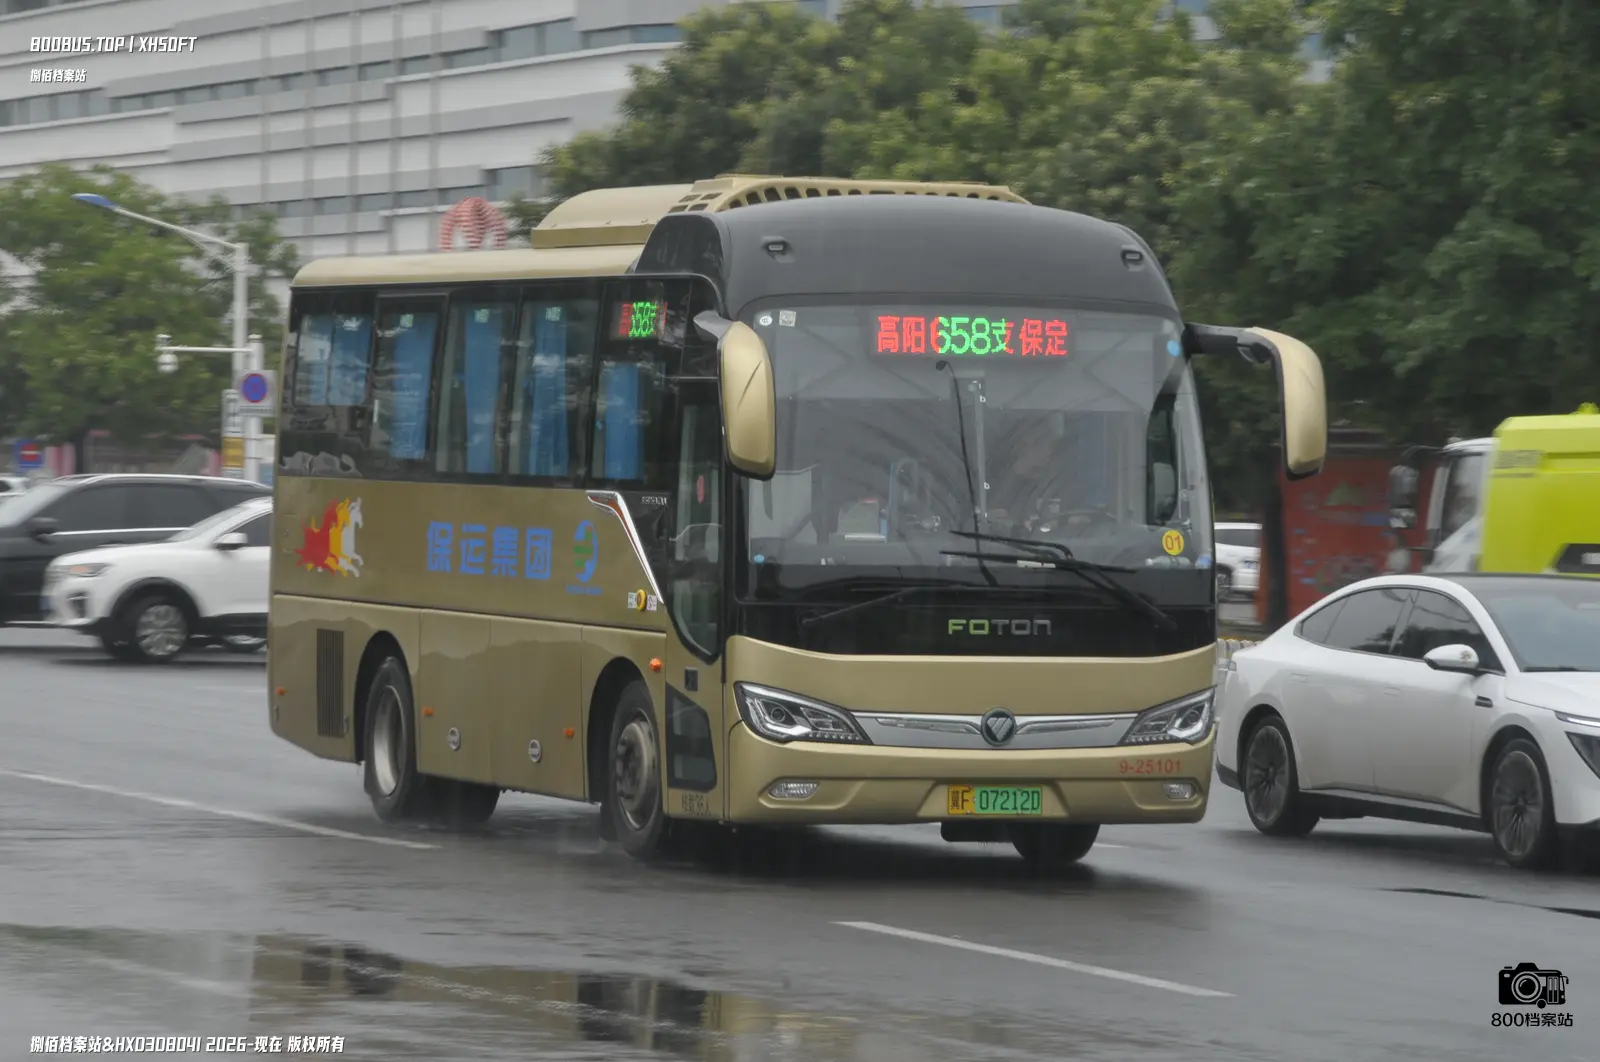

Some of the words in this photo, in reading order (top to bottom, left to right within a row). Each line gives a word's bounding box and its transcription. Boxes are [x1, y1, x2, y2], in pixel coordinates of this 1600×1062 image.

[877, 315, 926, 354] 高阳
[929, 315, 1015, 355] 658支
[1018, 317, 1069, 357] 保定
[425, 520, 554, 581] 保运集团
[1164, 534, 1183, 551] 01
[947, 618, 1053, 636] FOTON
[1118, 759, 1182, 775] 9-25101
[979, 789, 1041, 811] 07212D
